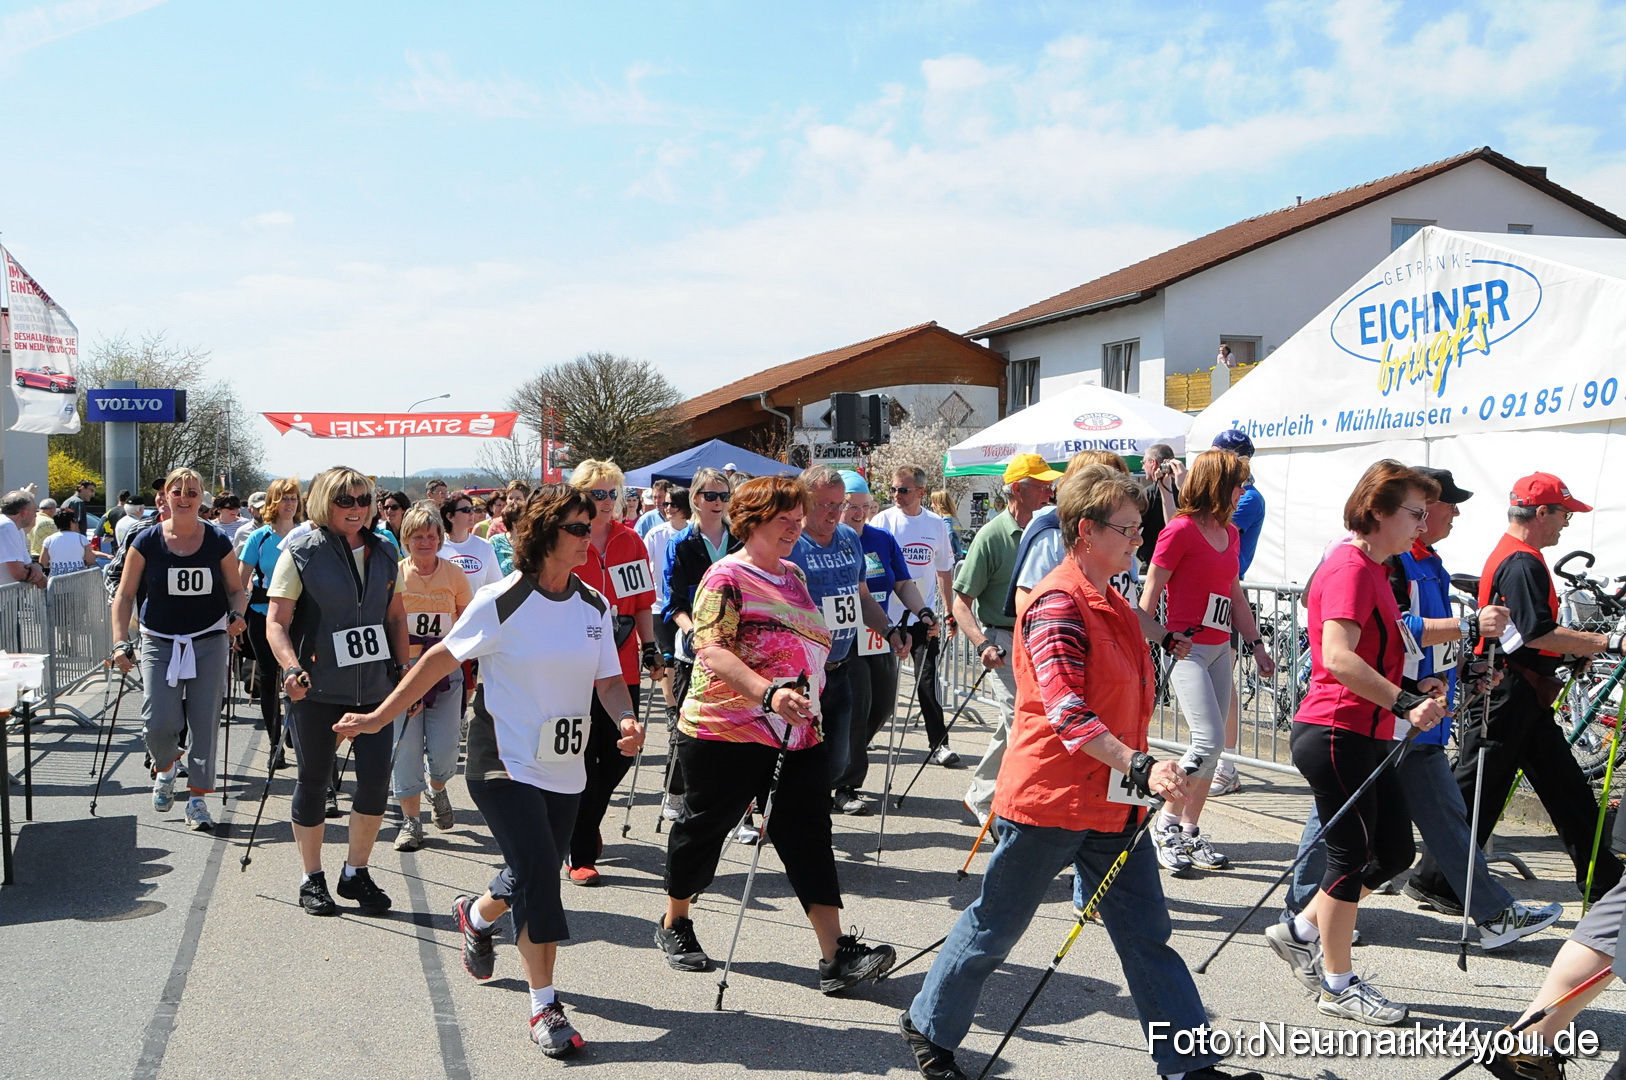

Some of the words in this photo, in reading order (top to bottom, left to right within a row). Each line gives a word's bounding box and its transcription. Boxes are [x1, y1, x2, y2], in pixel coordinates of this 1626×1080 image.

[1384, 252, 1471, 286] GETRÄNKE
[1359, 279, 1510, 345] EICHNER
[95, 398, 163, 411] VOLVO
[1336, 407, 1452, 432] Mühlhausen
[1064, 438, 1138, 452] ERDINGER
[177, 569, 204, 592] 80
[617, 563, 646, 592] 101
[834, 595, 856, 625] 53
[416, 613, 442, 636] 84
[345, 627, 380, 659] 88
[866, 628, 883, 650] 79
[553, 718, 583, 756] 85
